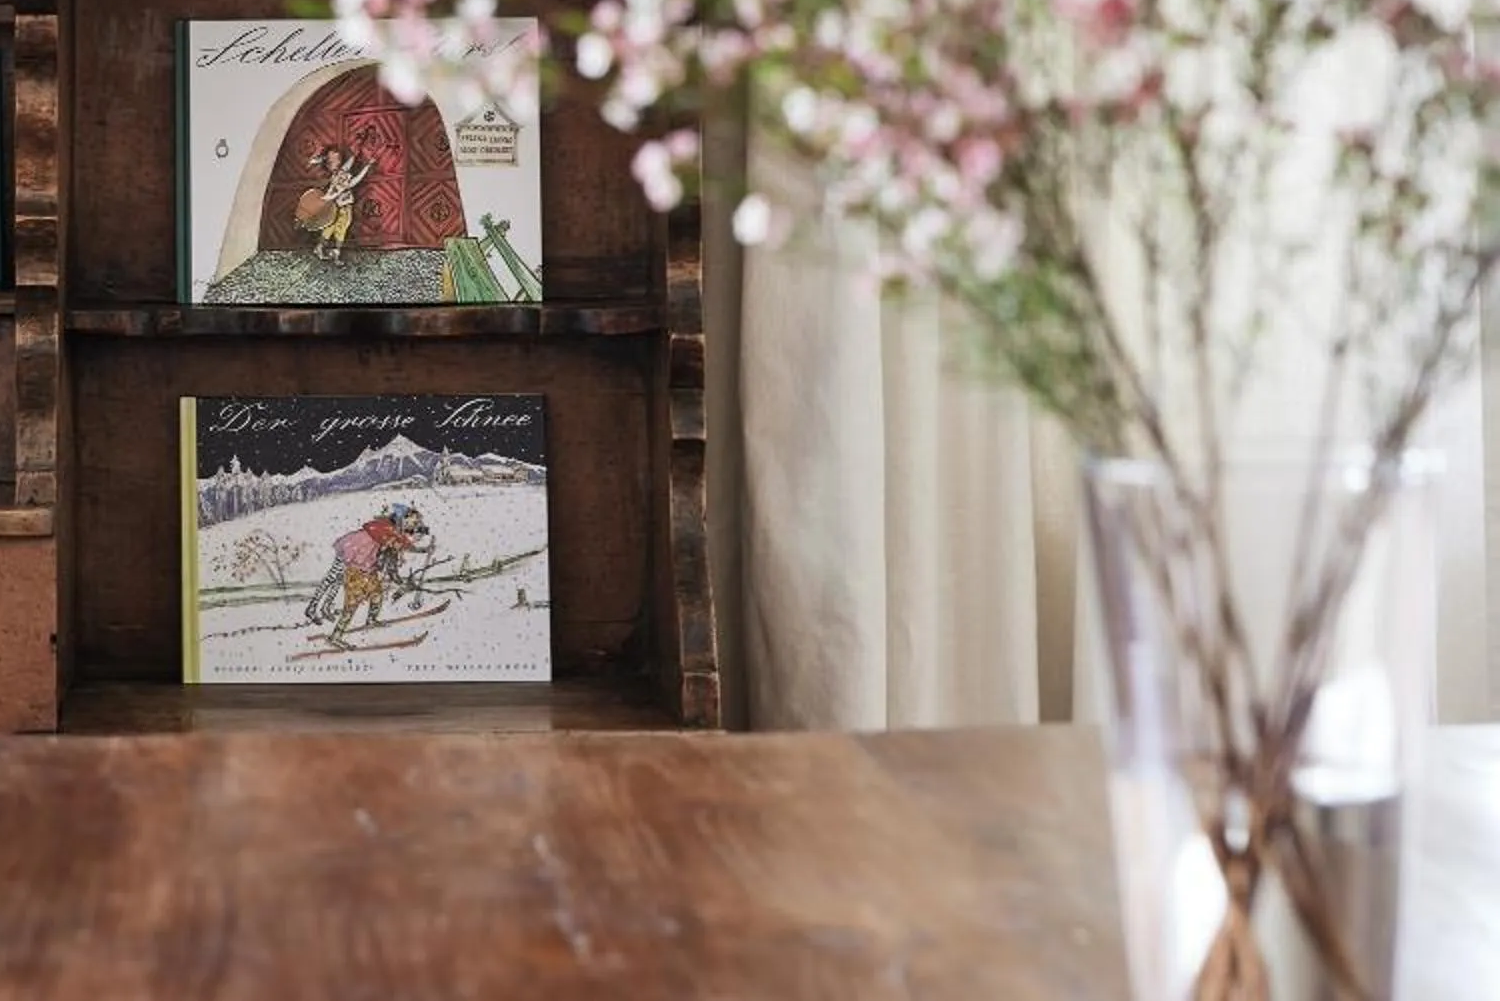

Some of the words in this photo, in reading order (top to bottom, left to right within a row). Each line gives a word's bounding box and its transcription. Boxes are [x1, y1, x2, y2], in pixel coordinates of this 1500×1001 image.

[209, 403, 298, 432] Der
[312, 414, 416, 442] grosse
[435, 399, 533, 429] Schnee
